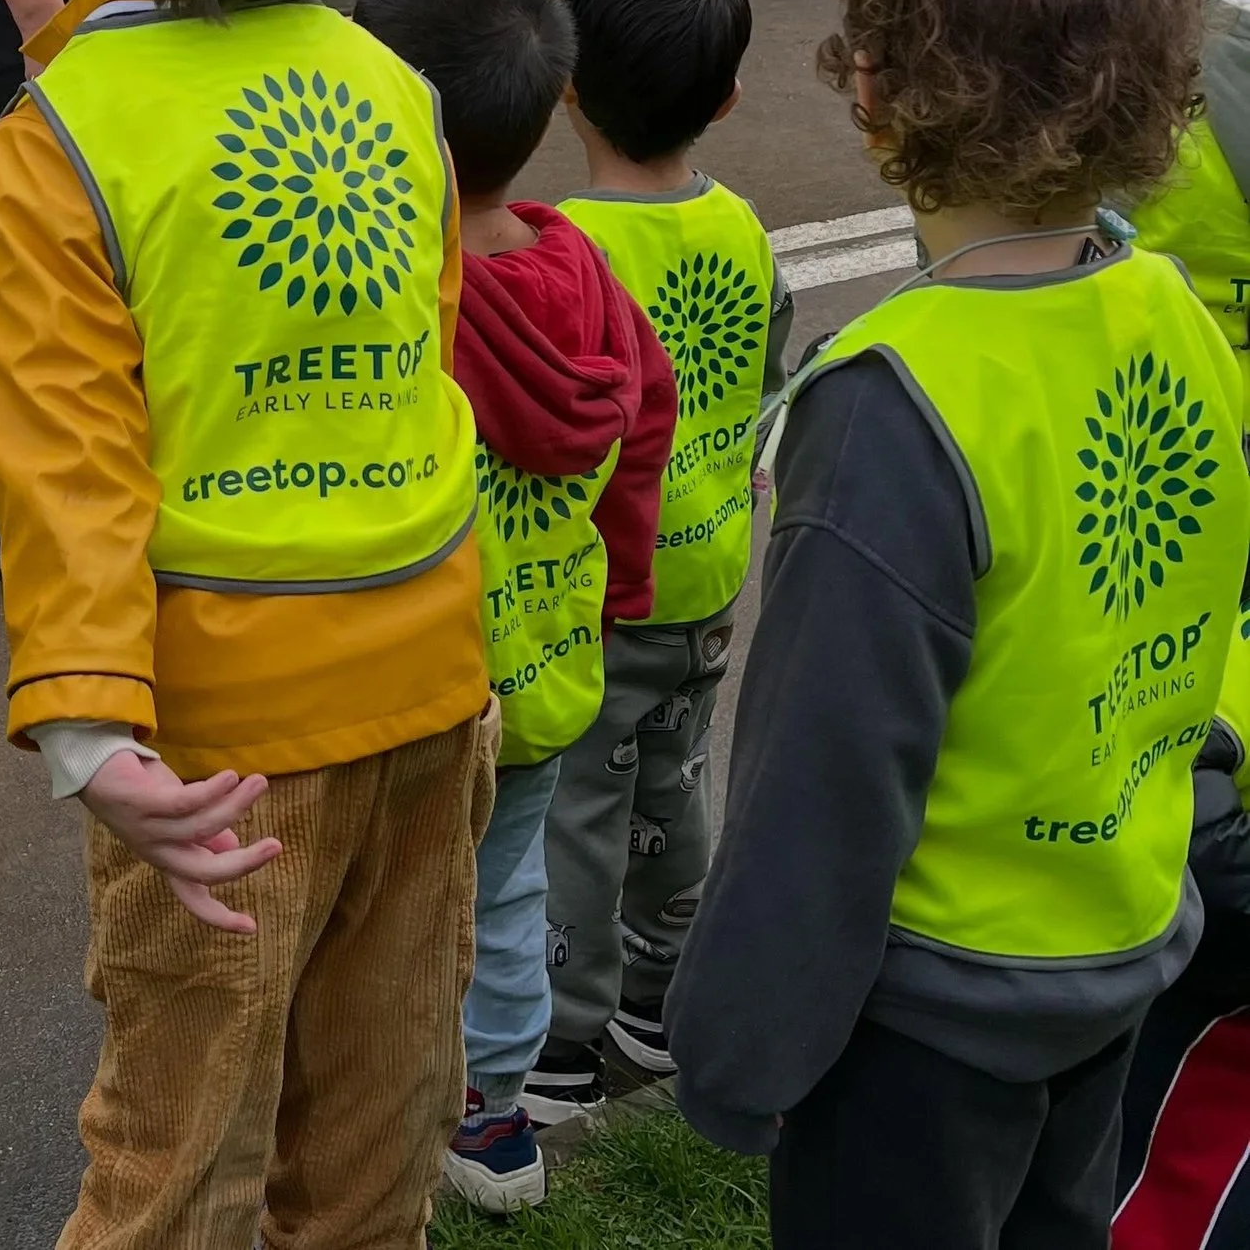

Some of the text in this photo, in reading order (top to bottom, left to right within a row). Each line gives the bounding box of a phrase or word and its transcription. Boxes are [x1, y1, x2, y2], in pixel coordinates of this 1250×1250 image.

[234, 333, 426, 398] TREETOP
[235, 386, 418, 422] EARLY LEARNING
[667, 417, 750, 482] TREETOP
